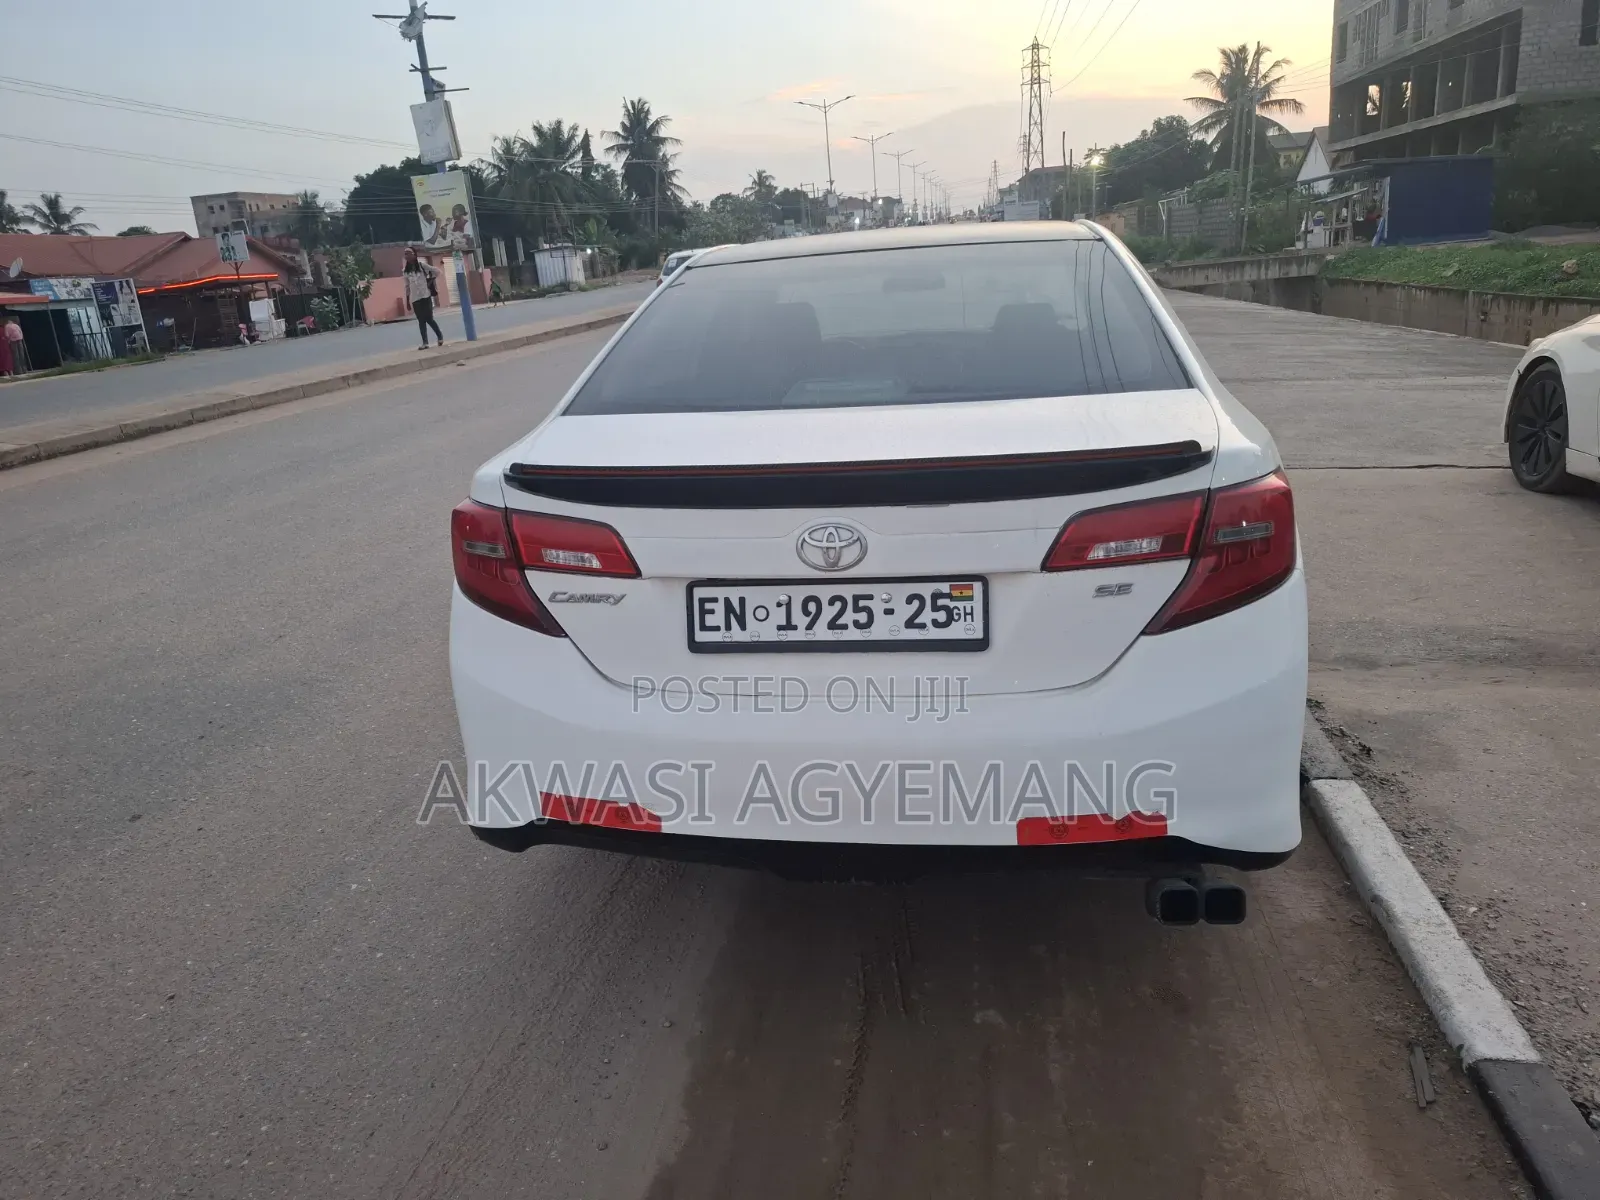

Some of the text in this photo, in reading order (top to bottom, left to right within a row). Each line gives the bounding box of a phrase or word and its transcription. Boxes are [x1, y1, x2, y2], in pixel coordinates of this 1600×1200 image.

[547, 591, 627, 606] CAMRY
[1091, 582, 1134, 599] SE
[697, 596, 747, 632] EN
[951, 604, 975, 623] GH
